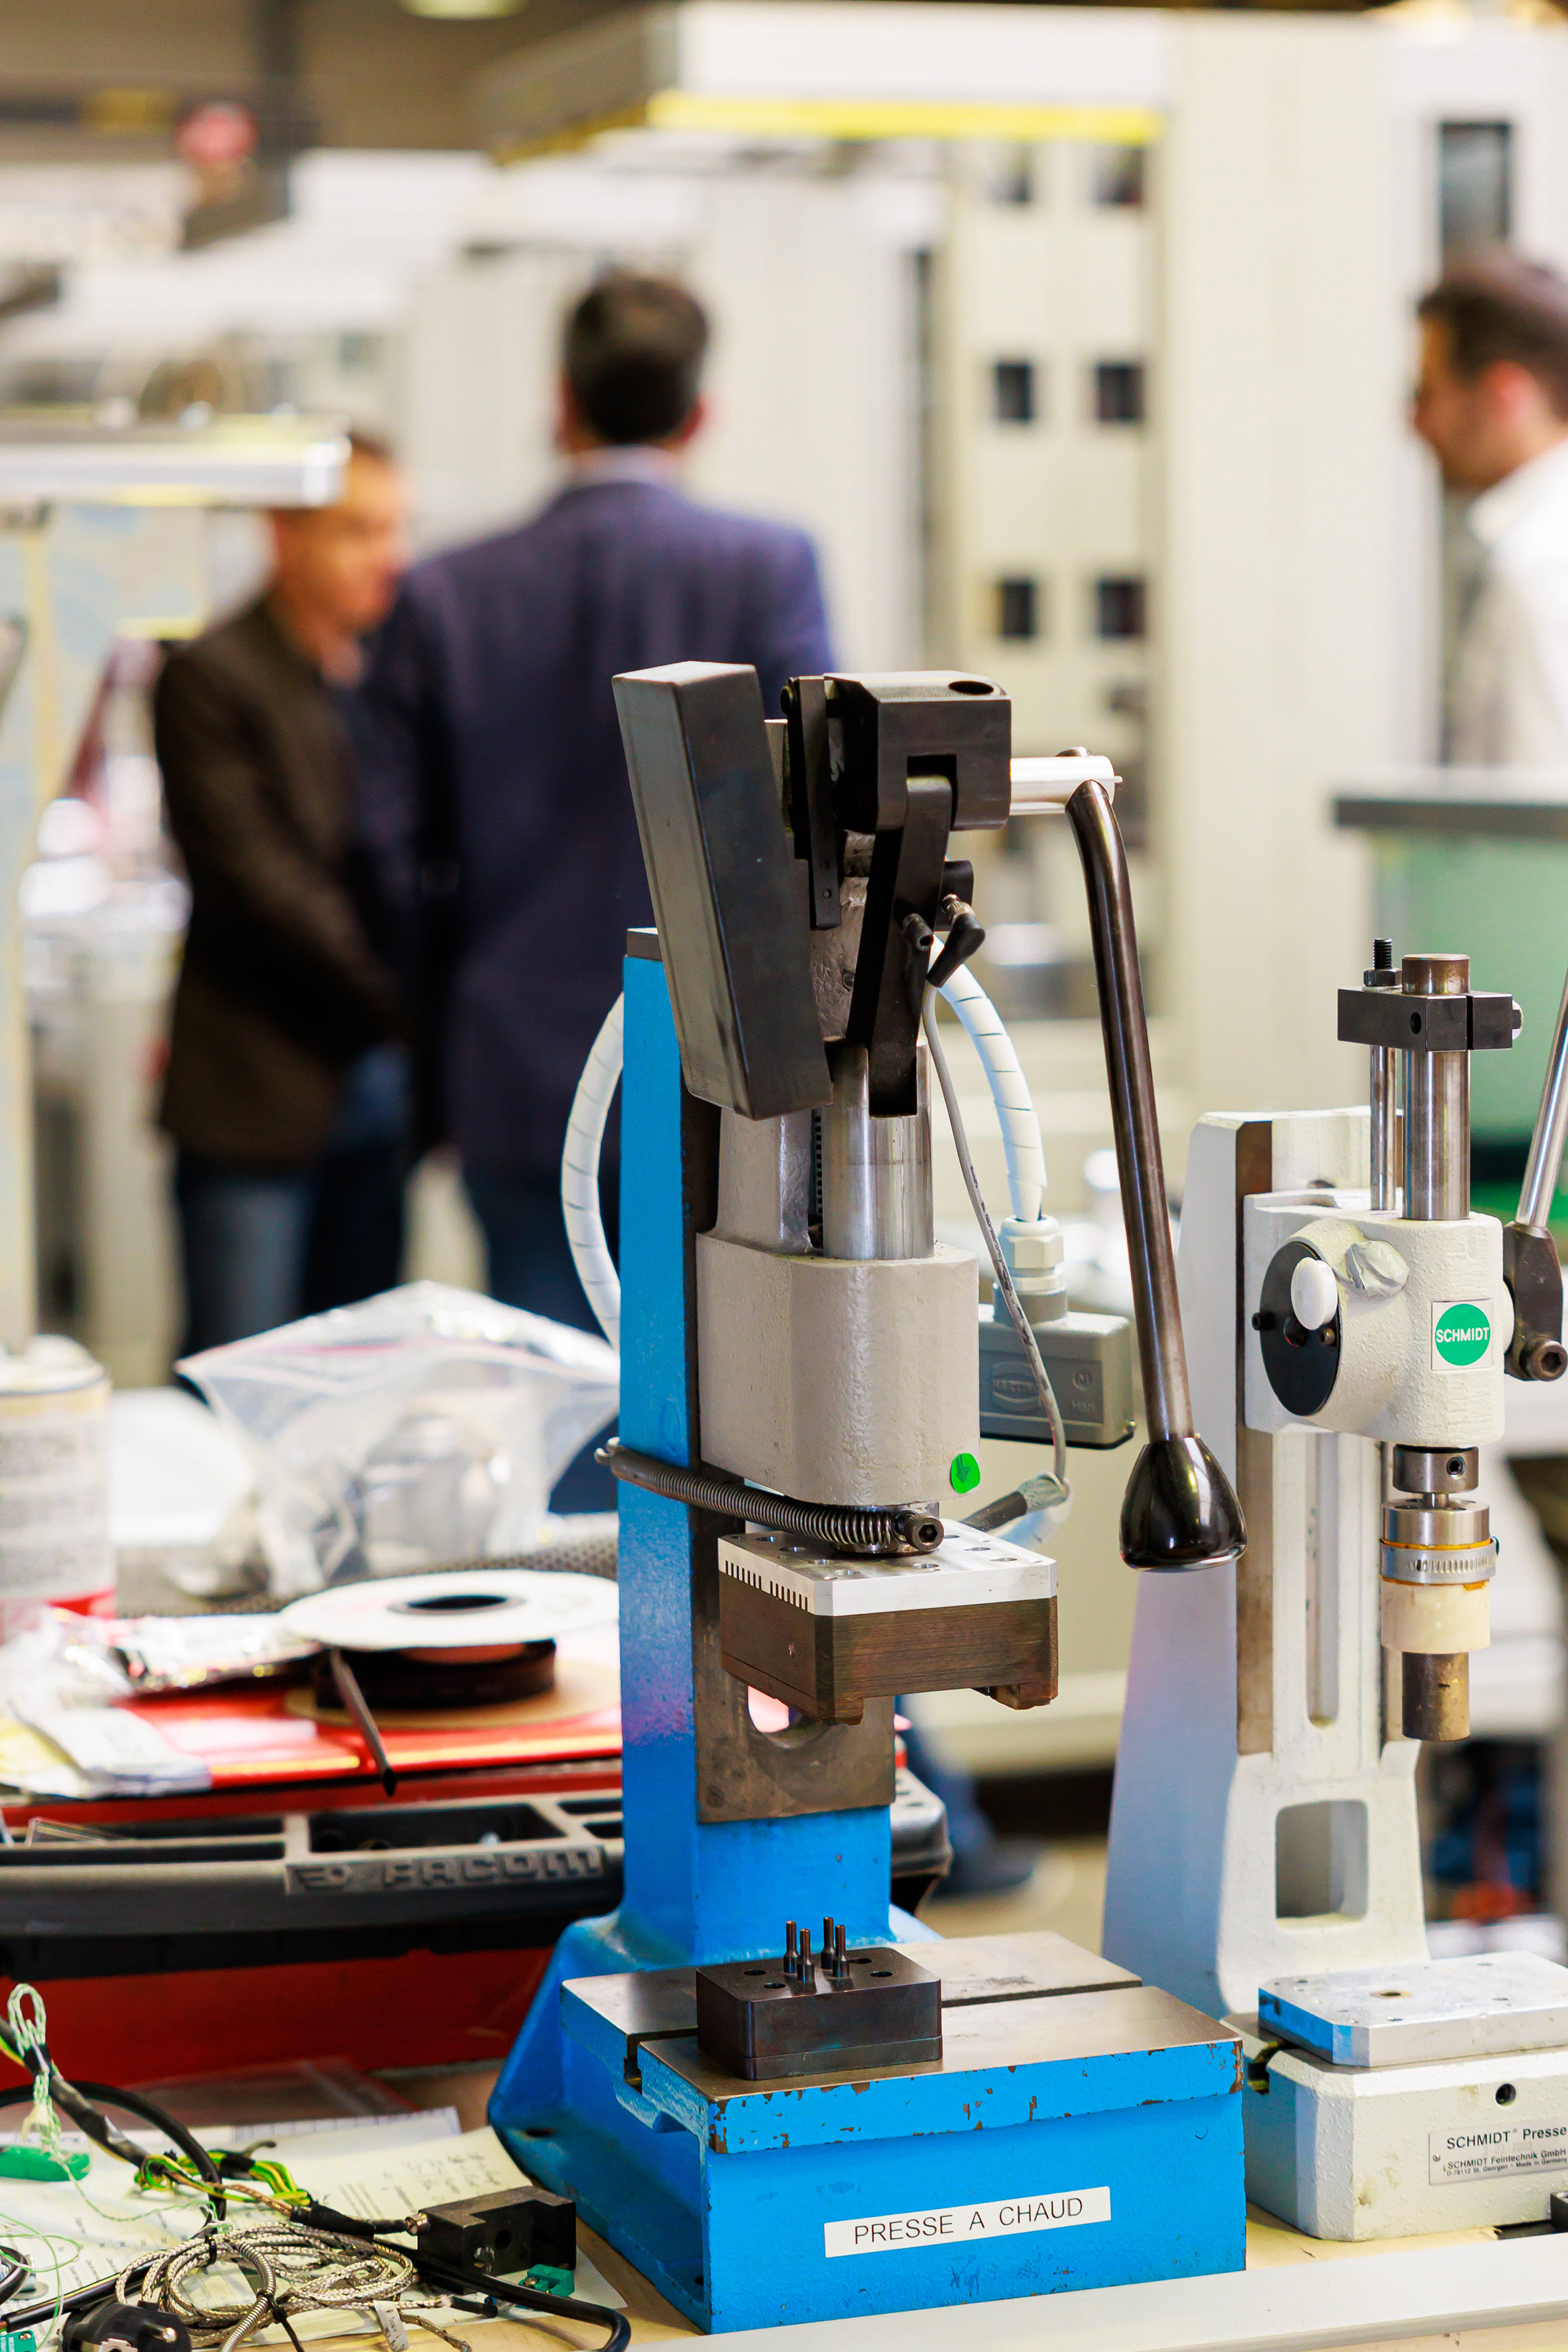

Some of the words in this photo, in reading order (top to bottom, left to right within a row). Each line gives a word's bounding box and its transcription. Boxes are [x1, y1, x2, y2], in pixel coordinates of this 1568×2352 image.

[1436, 1327, 1490, 1343] SCHMIDT
[1523, 2126, 1567, 2140] Presse
[1448, 2158, 1487, 2169] SCHMIDT
[1491, 2151, 1537, 2164] Feintechnik
[1540, 2148, 1566, 2158] GmbH
[854, 2214, 955, 2245] PRESSE
[968, 2211, 985, 2231] A
[999, 2197, 1084, 2227] CHAUD
